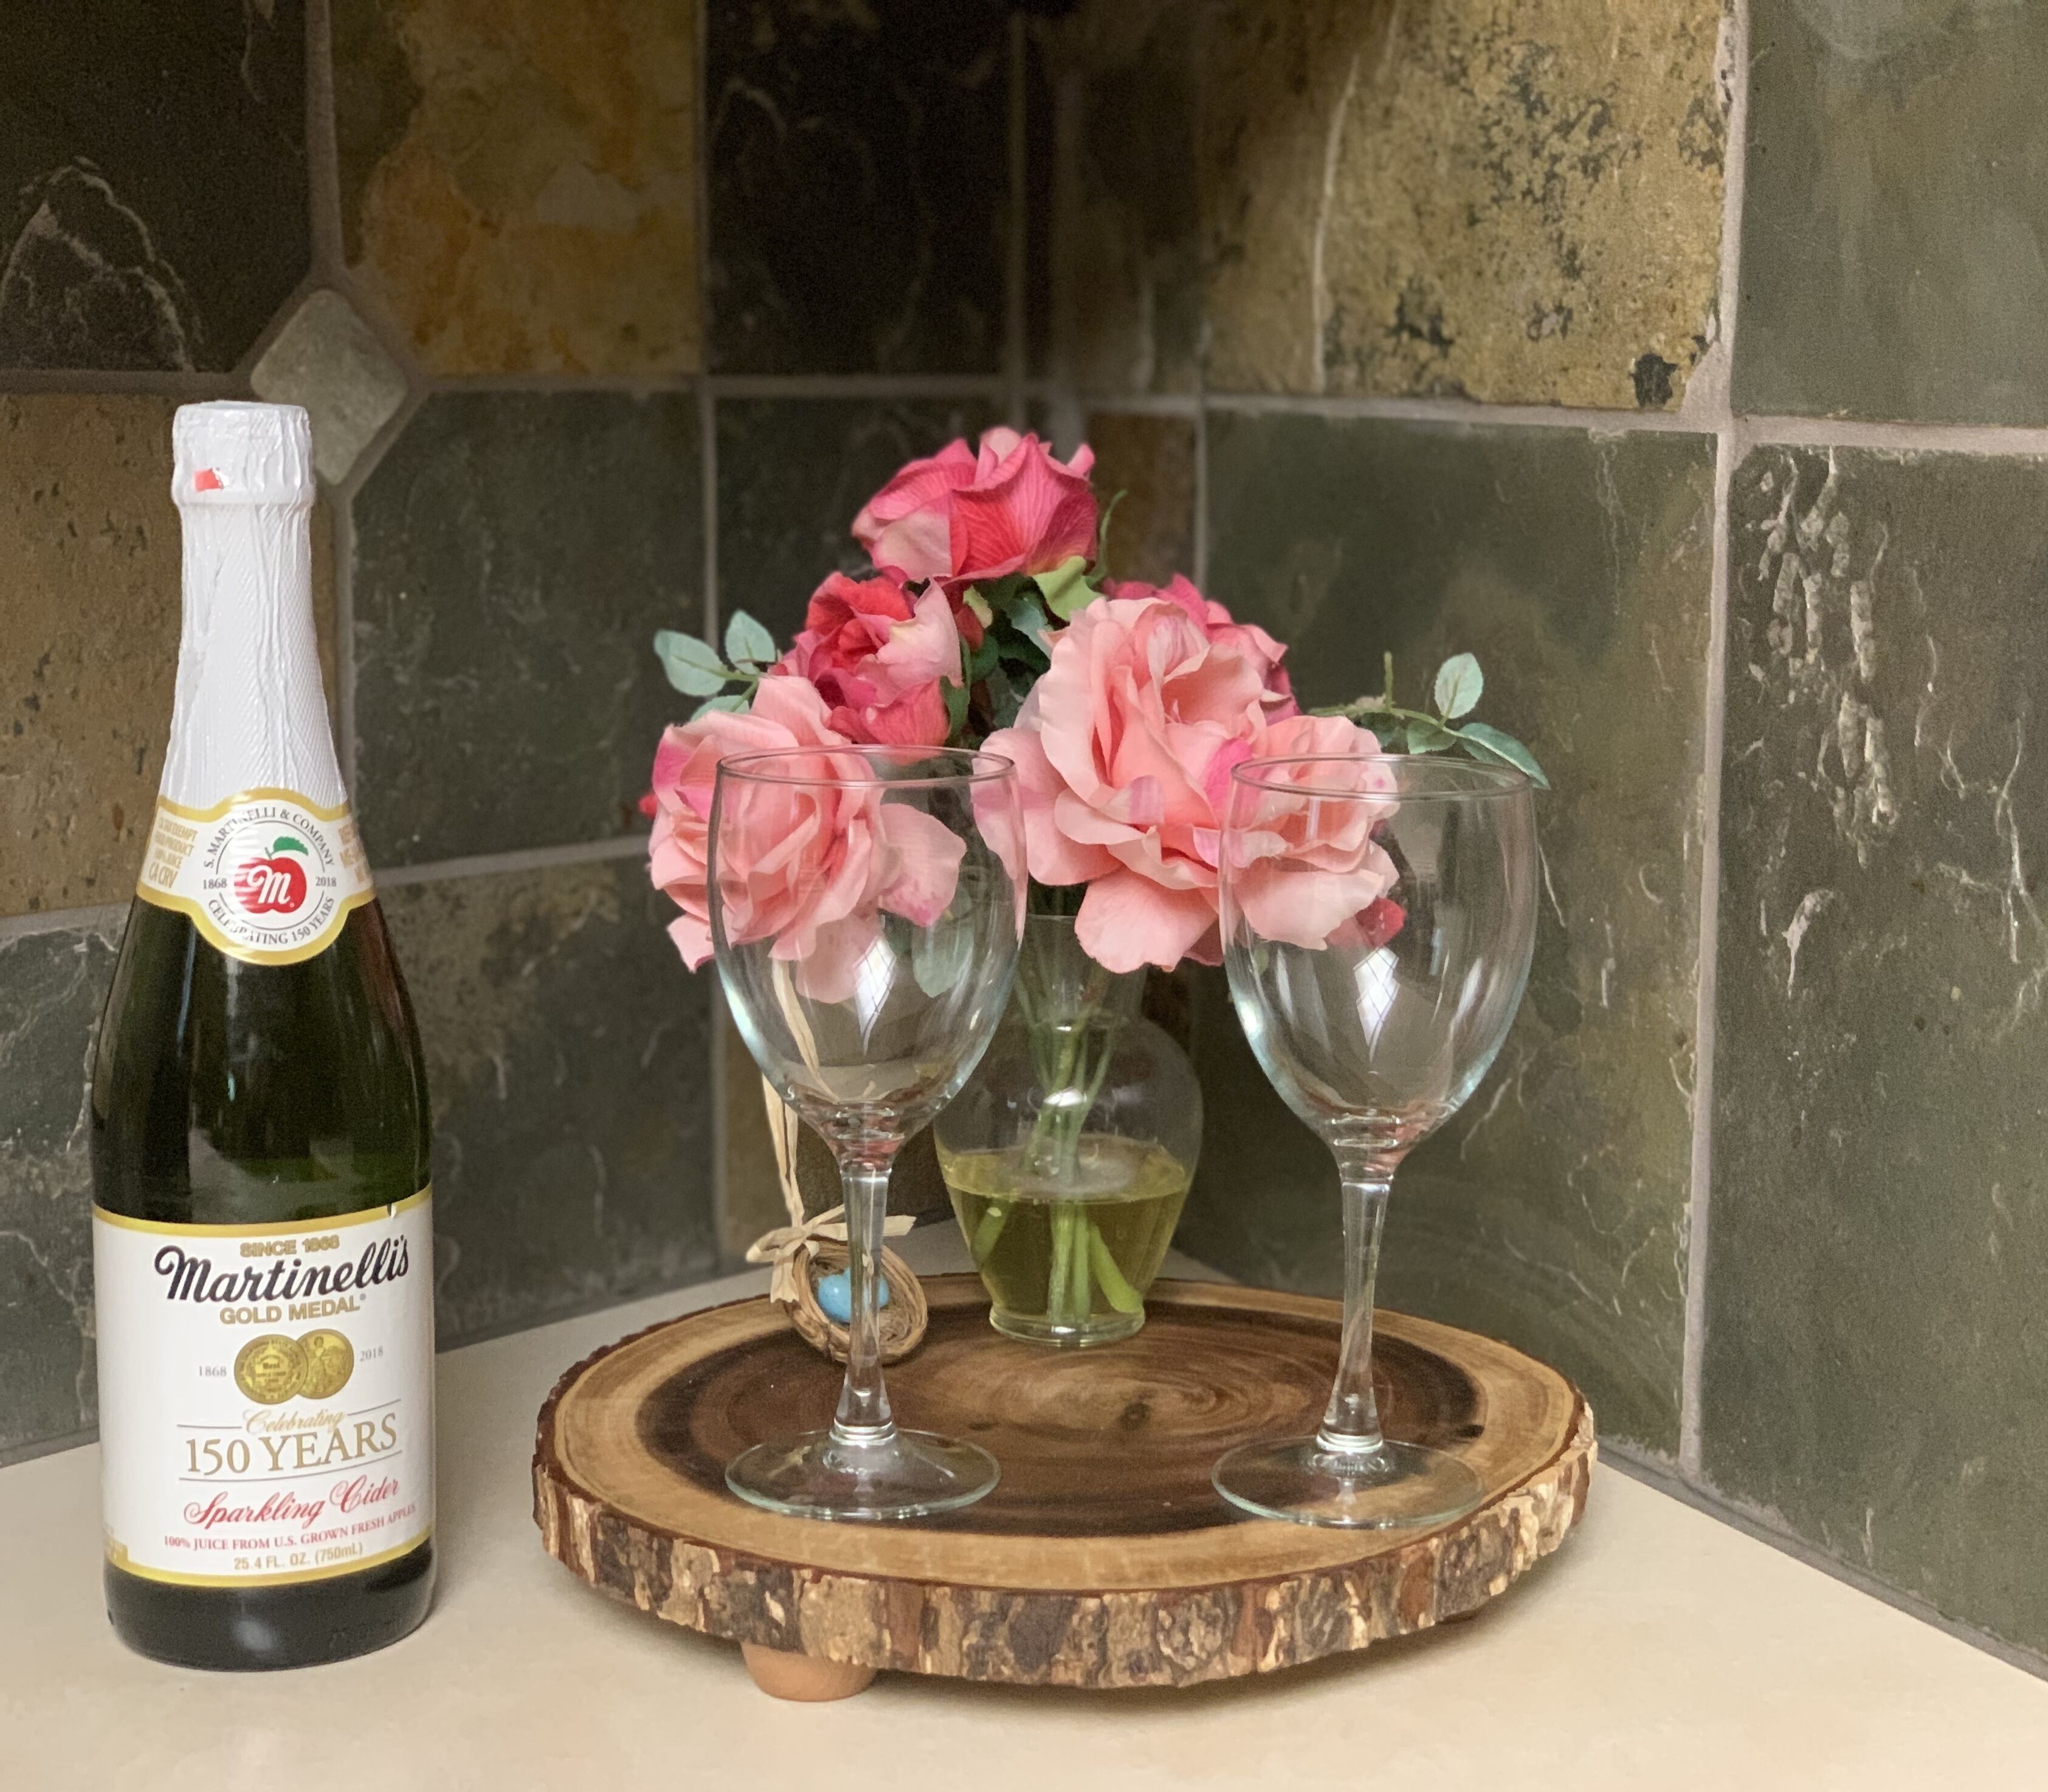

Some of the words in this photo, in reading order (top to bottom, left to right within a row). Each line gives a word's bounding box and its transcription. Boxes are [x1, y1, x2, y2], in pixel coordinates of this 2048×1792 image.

[280, 808, 289, 820] &
[292, 813, 334, 866] COMPANY
[203, 878, 227, 889] 1868
[315, 876, 337, 887] 2018
[292, 926, 311, 942] 150
[309, 896, 334, 930] YEARS
[240, 1239, 297, 1258] SINCE
[154, 1235, 410, 1303] Martinelli's
[219, 1306, 282, 1325] GOLD
[359, 1345, 384, 1362] 2018
[198, 1365, 227, 1377] 1868
[243, 1409, 344, 1435] Celebrating
[185, 1438, 250, 1476] 150
[258, 1413, 397, 1472] YEARS
[184, 1491, 326, 1529] Sparkling
[329, 1474, 399, 1513] Cider
[164, 1535, 191, 1548] 100%
[194, 1537, 229, 1551] JUICE
[232, 1537, 270, 1550] FROM
[274, 1535, 297, 1548] U.S.
[300, 1526, 348, 1545] GROWN
[351, 1516, 384, 1535] FRESH
[234, 1556, 262, 1570] 25.4
[266, 1554, 285, 1569] FL.
[290, 1552, 311, 1567] OZ.
[314, 1542, 364, 1565] (750mL)
